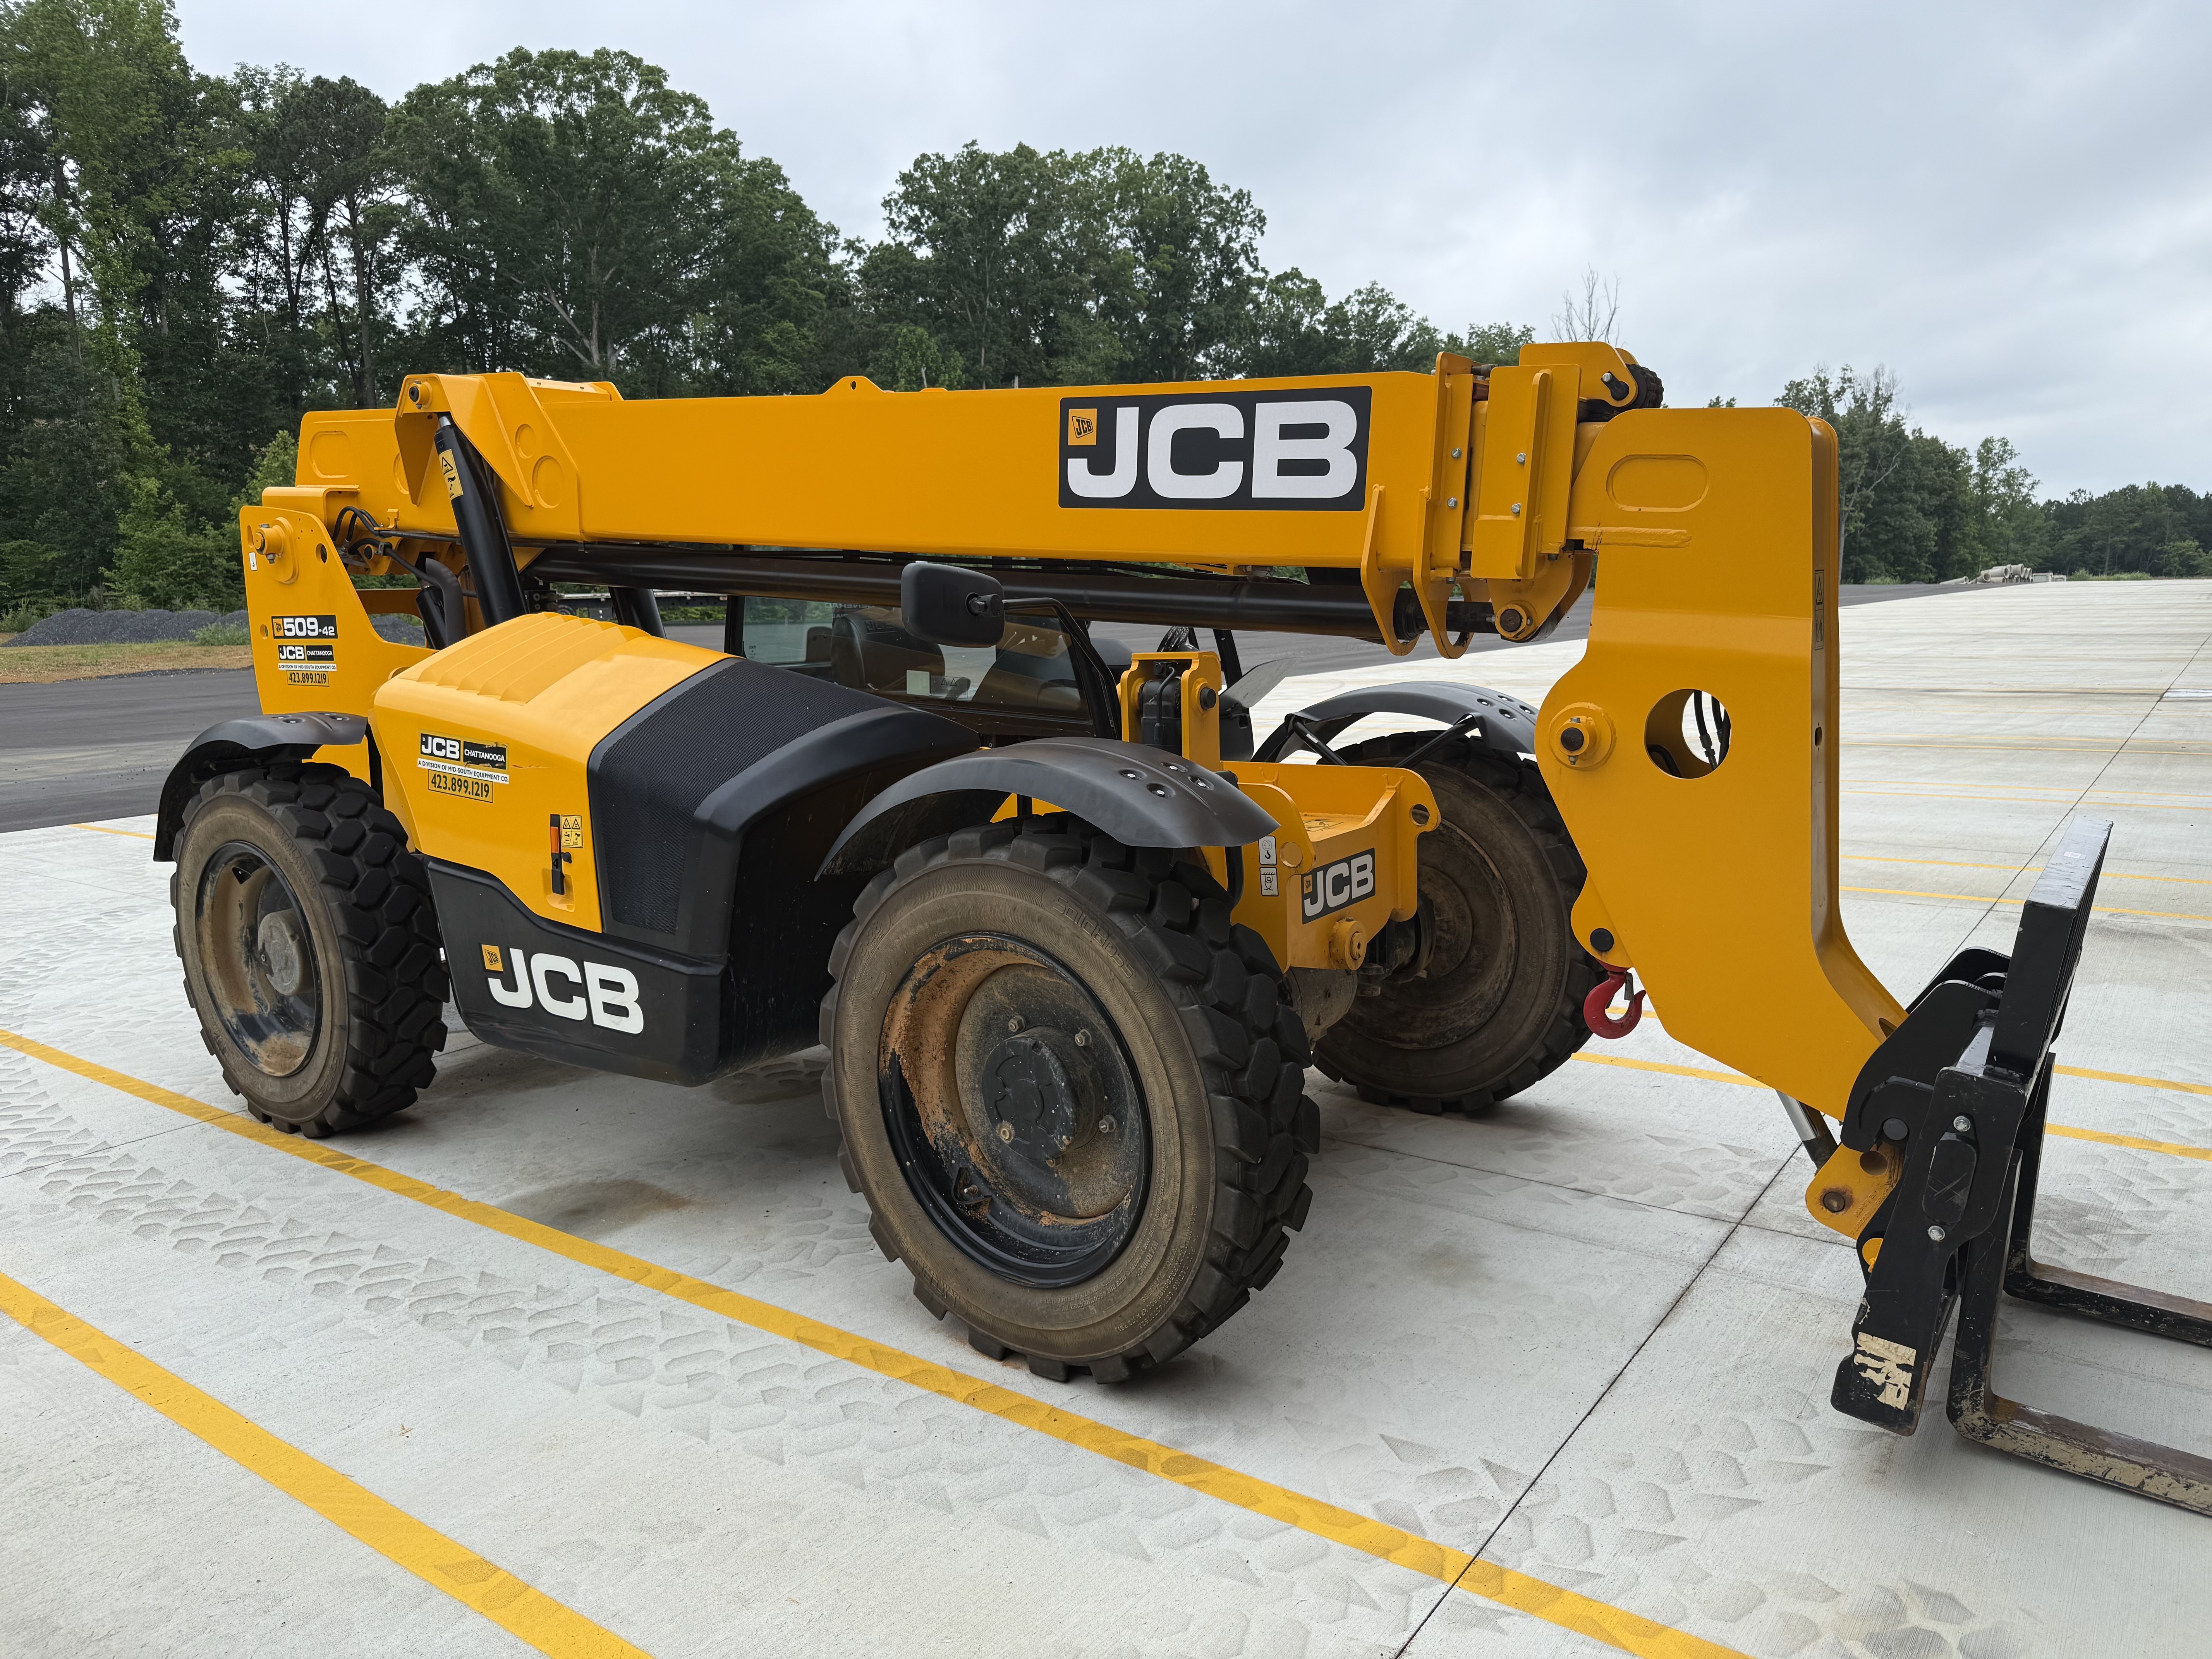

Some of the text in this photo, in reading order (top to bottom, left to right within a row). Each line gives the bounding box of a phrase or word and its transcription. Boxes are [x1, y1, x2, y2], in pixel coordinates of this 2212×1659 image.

[1076, 419, 1092, 436] JCB
[1068, 400, 1357, 498] JCB
[280, 646, 305, 659] JCB
[289, 672, 326, 684] 423.899.1219
[422, 737, 505, 762] JCB CHATTANOOGA
[448, 766, 473, 776] MID-SOUTH
[474, 771, 500, 781] EQUIPMENT
[431, 774, 489, 799] 423.899.1219
[1304, 854, 1374, 917] JCB
[487, 951, 499, 963] JCB
[488, 948, 644, 1034] JCB
[1133, 1240, 1161, 1278] WARNING:
